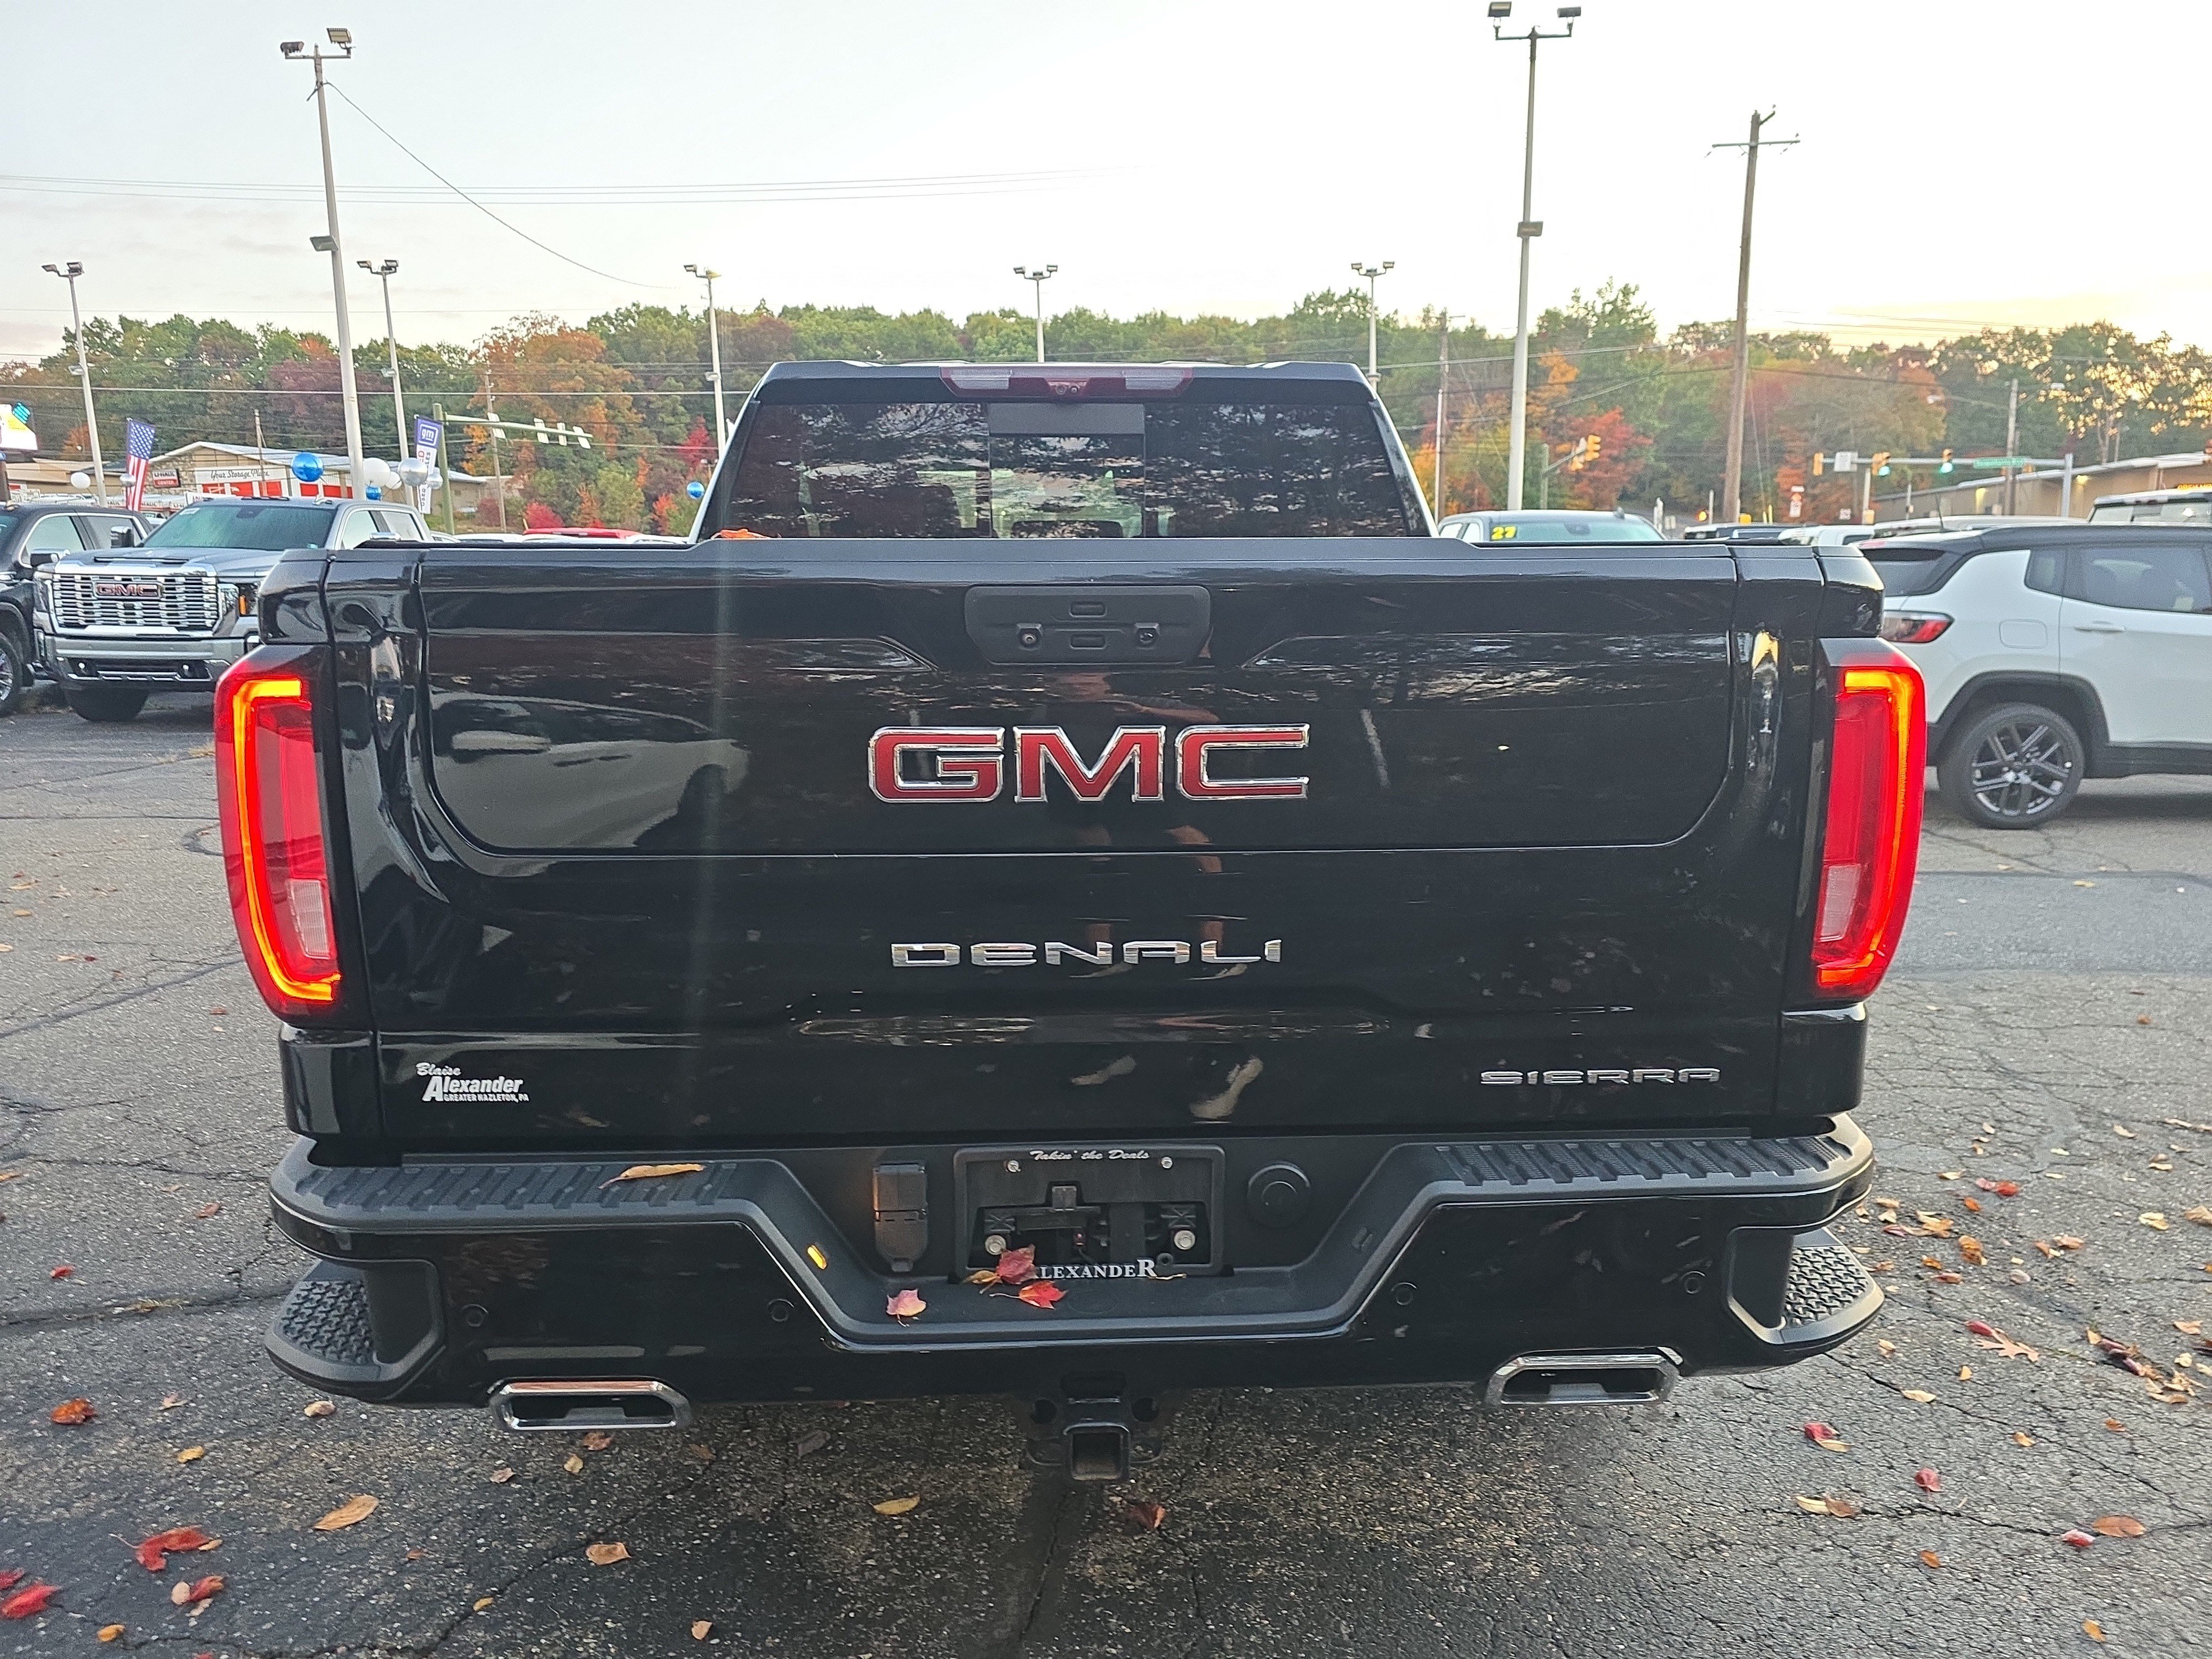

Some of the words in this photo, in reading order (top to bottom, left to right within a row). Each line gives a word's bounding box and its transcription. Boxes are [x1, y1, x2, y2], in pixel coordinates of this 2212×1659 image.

[421, 428, 434, 441] gm
[227, 470, 250, 479] Storage
[1491, 526, 1516, 540] 27
[97, 583, 158, 596] GMC
[869, 723, 1310, 803] GMC
[891, 939, 1282, 967] DENALI
[416, 1062, 461, 1076] Blaise
[1481, 1068, 1720, 1085] SIERRA
[422, 1076, 523, 1102] Alexander
[443, 1094, 477, 1102] GREATER
[518, 1094, 530, 1102] PA
[1081, 1150, 1103, 1160] the
[1108, 1149, 1149, 1159] Deals
[1033, 1259, 1157, 1278] LEXANDER
